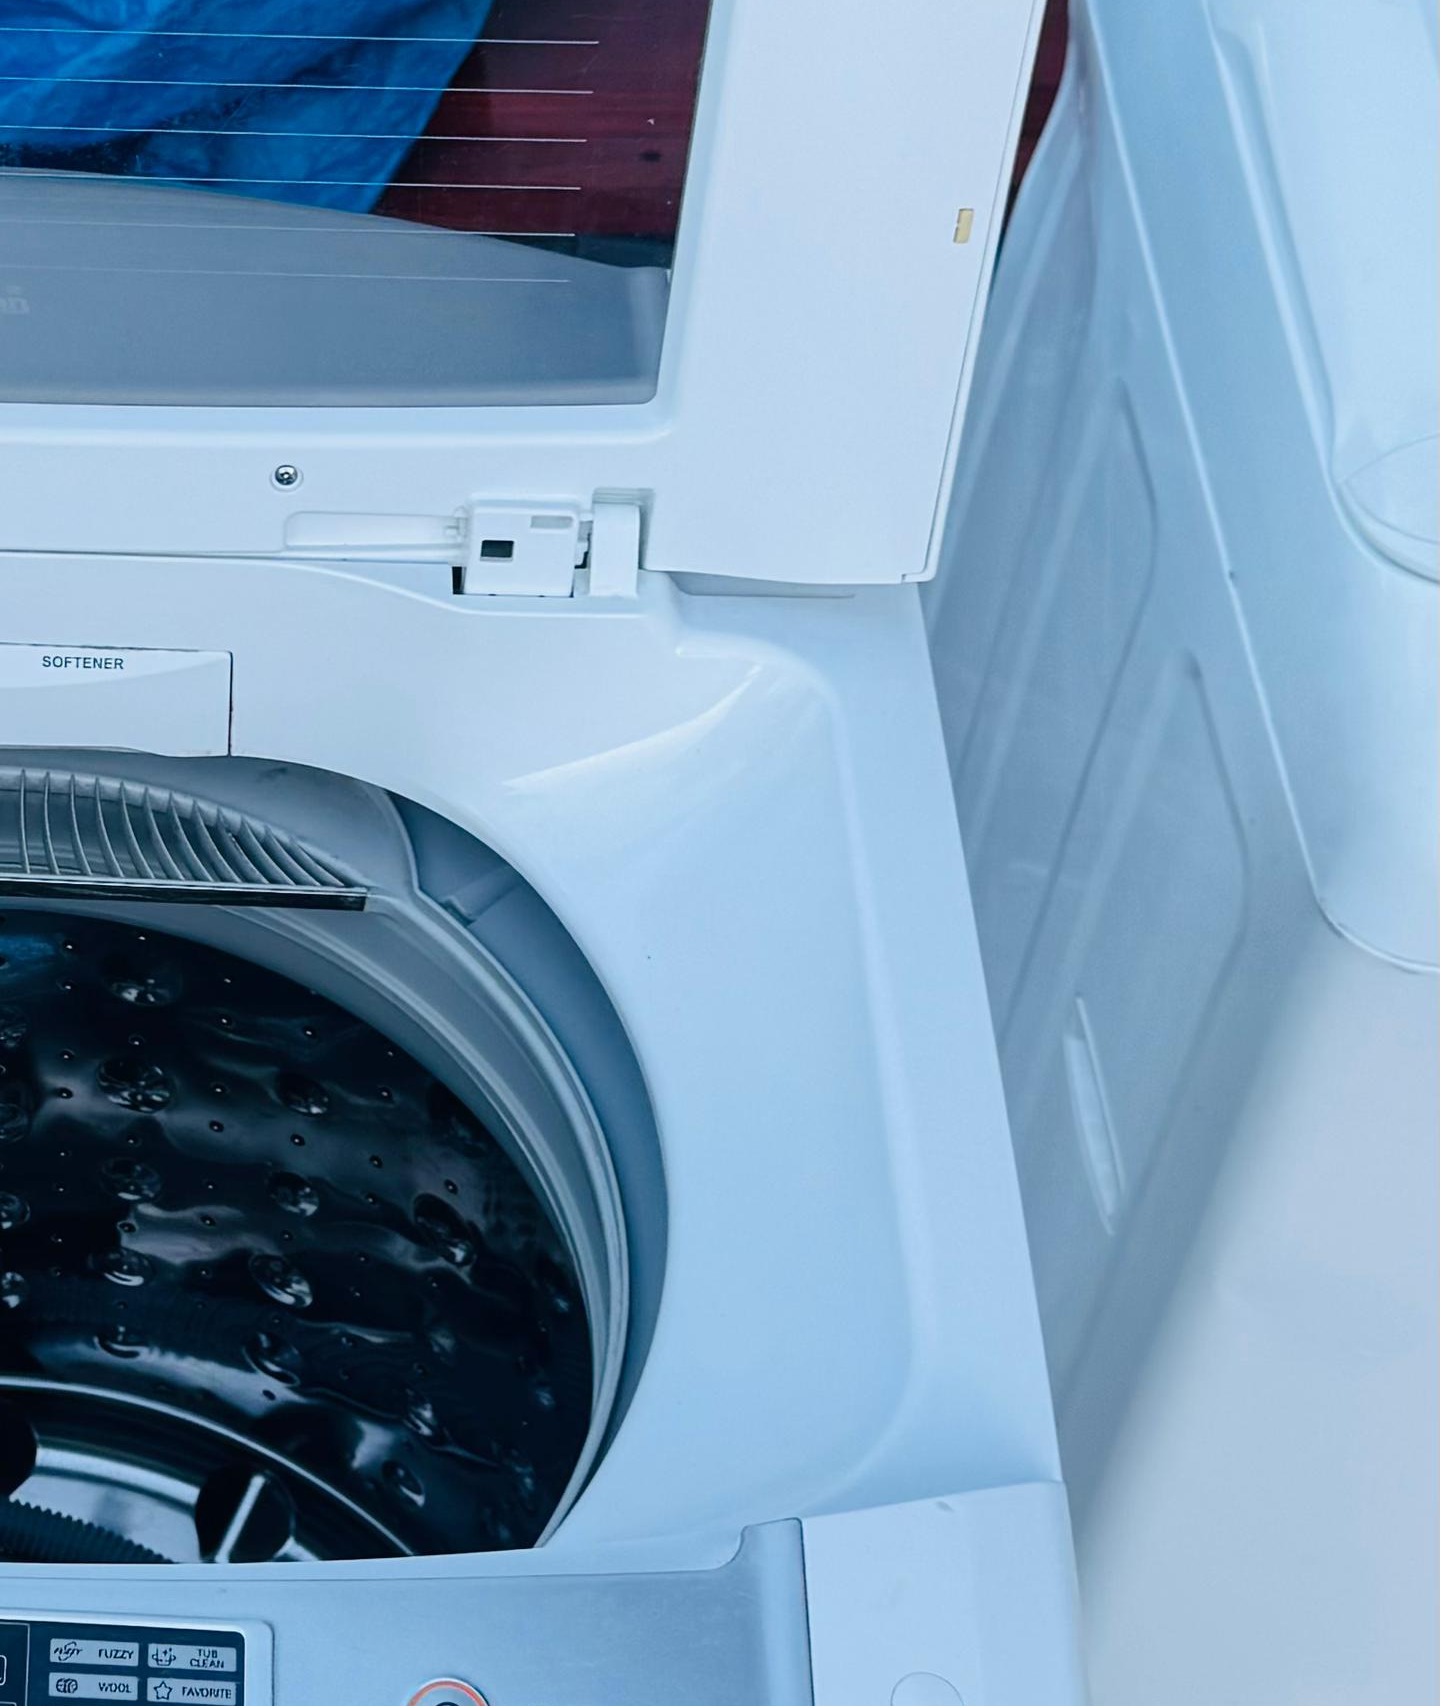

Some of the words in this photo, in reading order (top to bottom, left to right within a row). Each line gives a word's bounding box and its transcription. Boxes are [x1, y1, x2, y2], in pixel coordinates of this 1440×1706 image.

[42, 655, 124, 670] SOFTENER
[98, 1649, 134, 1660] FUZZY
[197, 1648, 218, 1658] TUB
[189, 1658, 225, 1669] CLEAN
[98, 1682, 132, 1694] WOOL
[181, 1686, 232, 1699] FAVORITE
